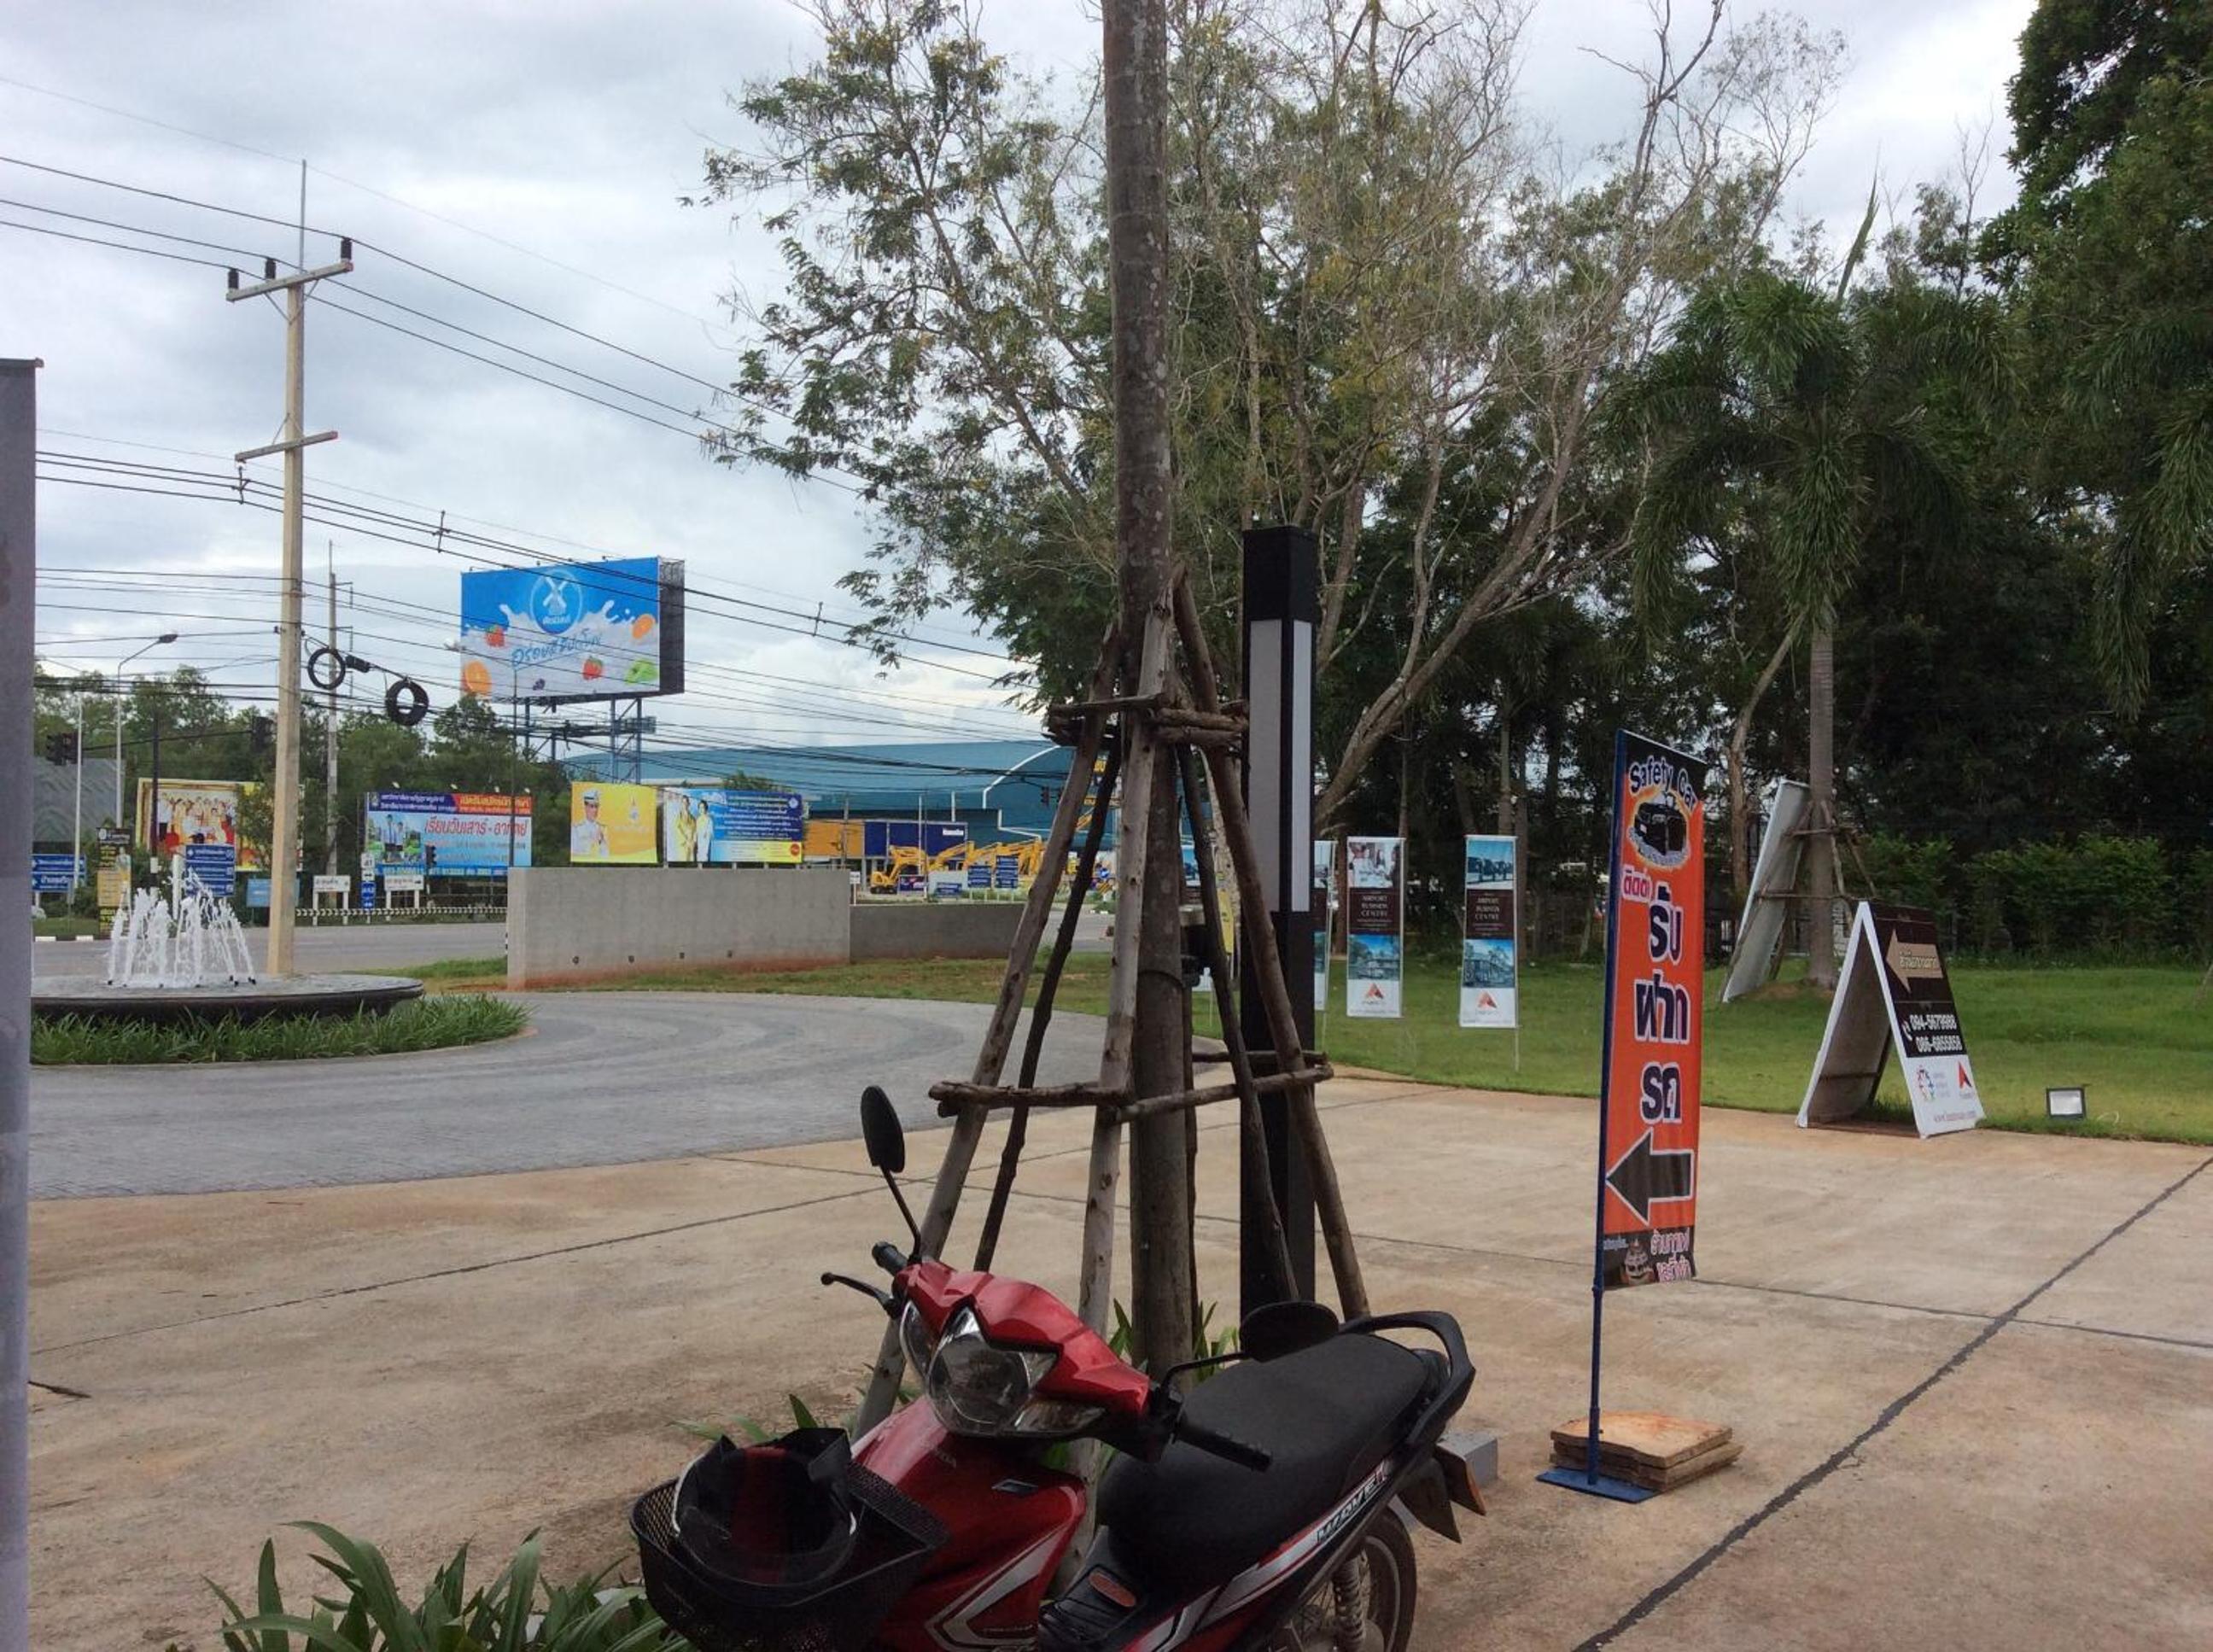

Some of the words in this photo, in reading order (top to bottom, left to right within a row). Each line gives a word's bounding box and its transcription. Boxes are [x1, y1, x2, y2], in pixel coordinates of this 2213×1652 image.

[1629, 755, 1673, 796] Safety
[1678, 768, 1698, 814] Car
[1634, 969, 1690, 1045] ฝาก
[1640, 1061, 1682, 1123] รถ
